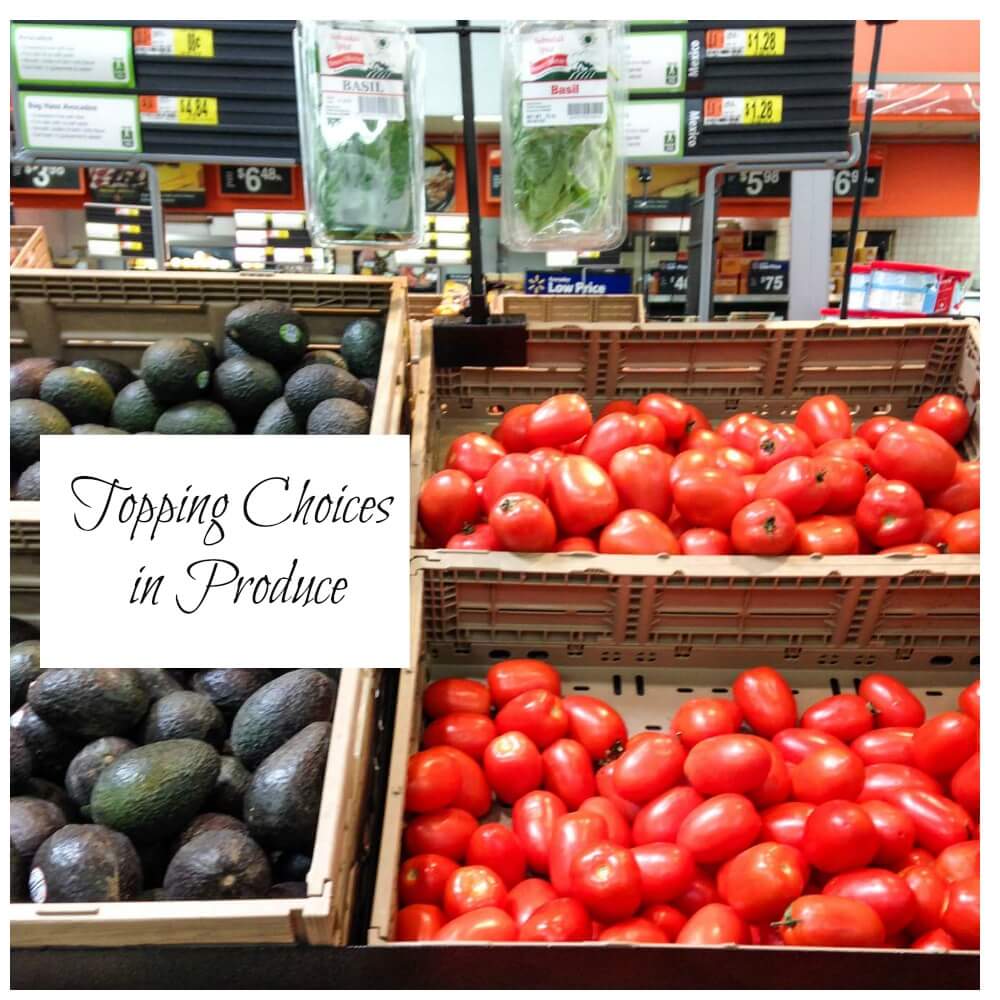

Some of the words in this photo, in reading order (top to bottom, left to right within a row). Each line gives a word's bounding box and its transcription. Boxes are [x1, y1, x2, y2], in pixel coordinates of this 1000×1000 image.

[747, 32, 776, 49] $1.28
[689, 40, 700, 77] Mexico
[343, 80, 383, 92] BASIL
[551, 84, 579, 95] Basil
[745, 100, 772, 118] $1.28
[689, 111, 699, 147] Mexico
[548, 277, 571, 294] Low
[576, 281, 606, 294] Price
[760, 276, 783, 291] $75
